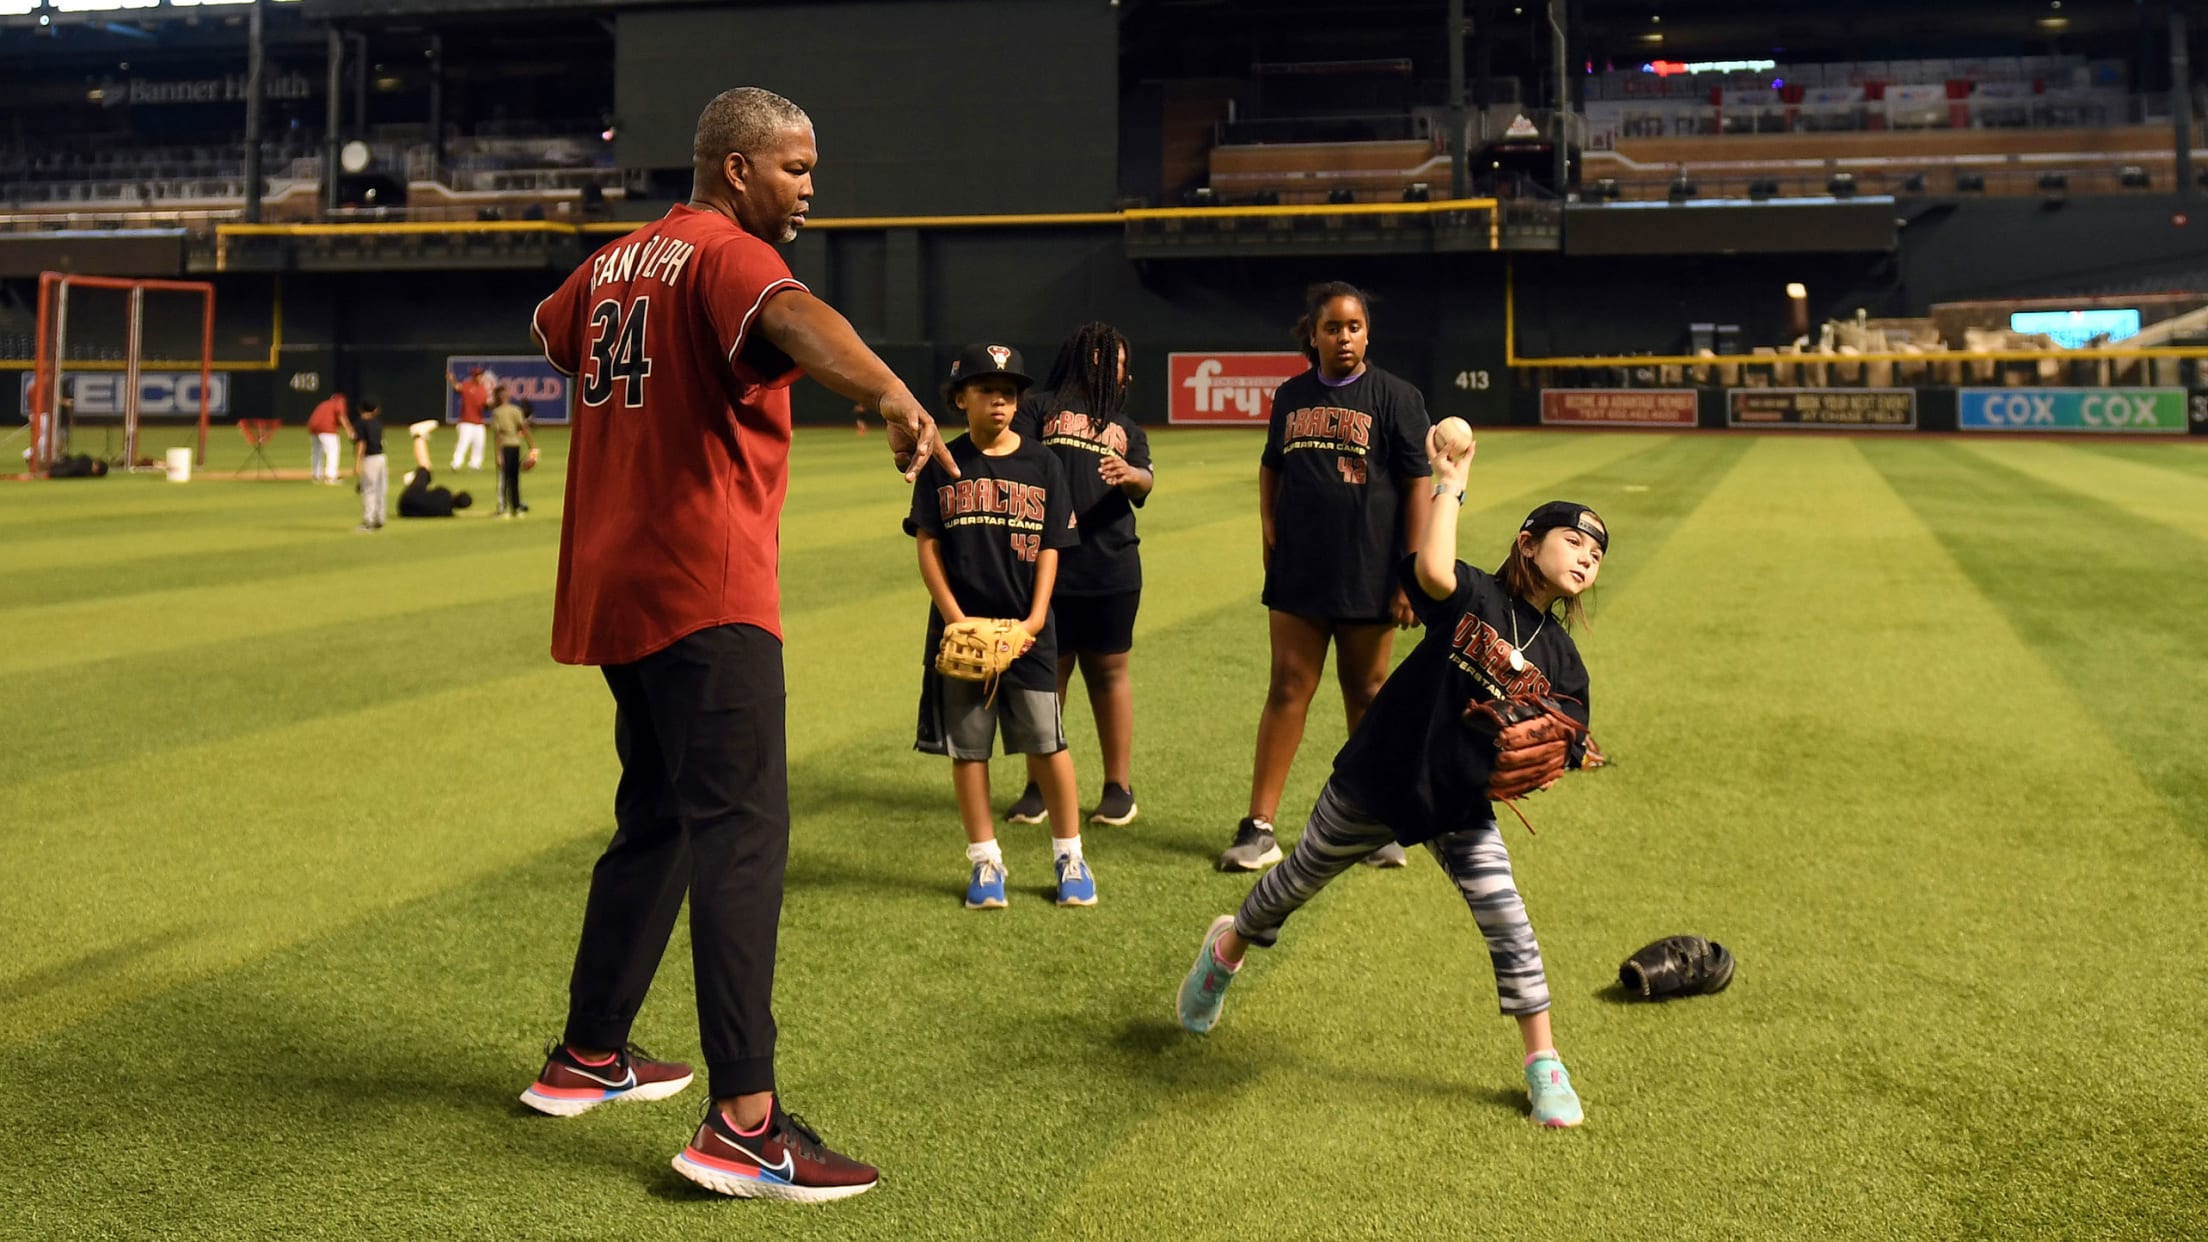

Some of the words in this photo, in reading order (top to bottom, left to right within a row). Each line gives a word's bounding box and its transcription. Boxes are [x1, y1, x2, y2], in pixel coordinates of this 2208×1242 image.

[130, 78, 220, 101] Banner
[225, 72, 310, 99] Hlth
[582, 295, 652, 408] 34
[289, 371, 320, 392] 413
[1182, 358, 1278, 417] fry'
[1454, 370, 1490, 390] 413
[1983, 395, 2055, 424] COX
[2081, 395, 2158, 425] COX
[1337, 455, 1368, 485] 42
[1007, 518, 1044, 532] CAMP
[1010, 532, 1042, 563] 42
